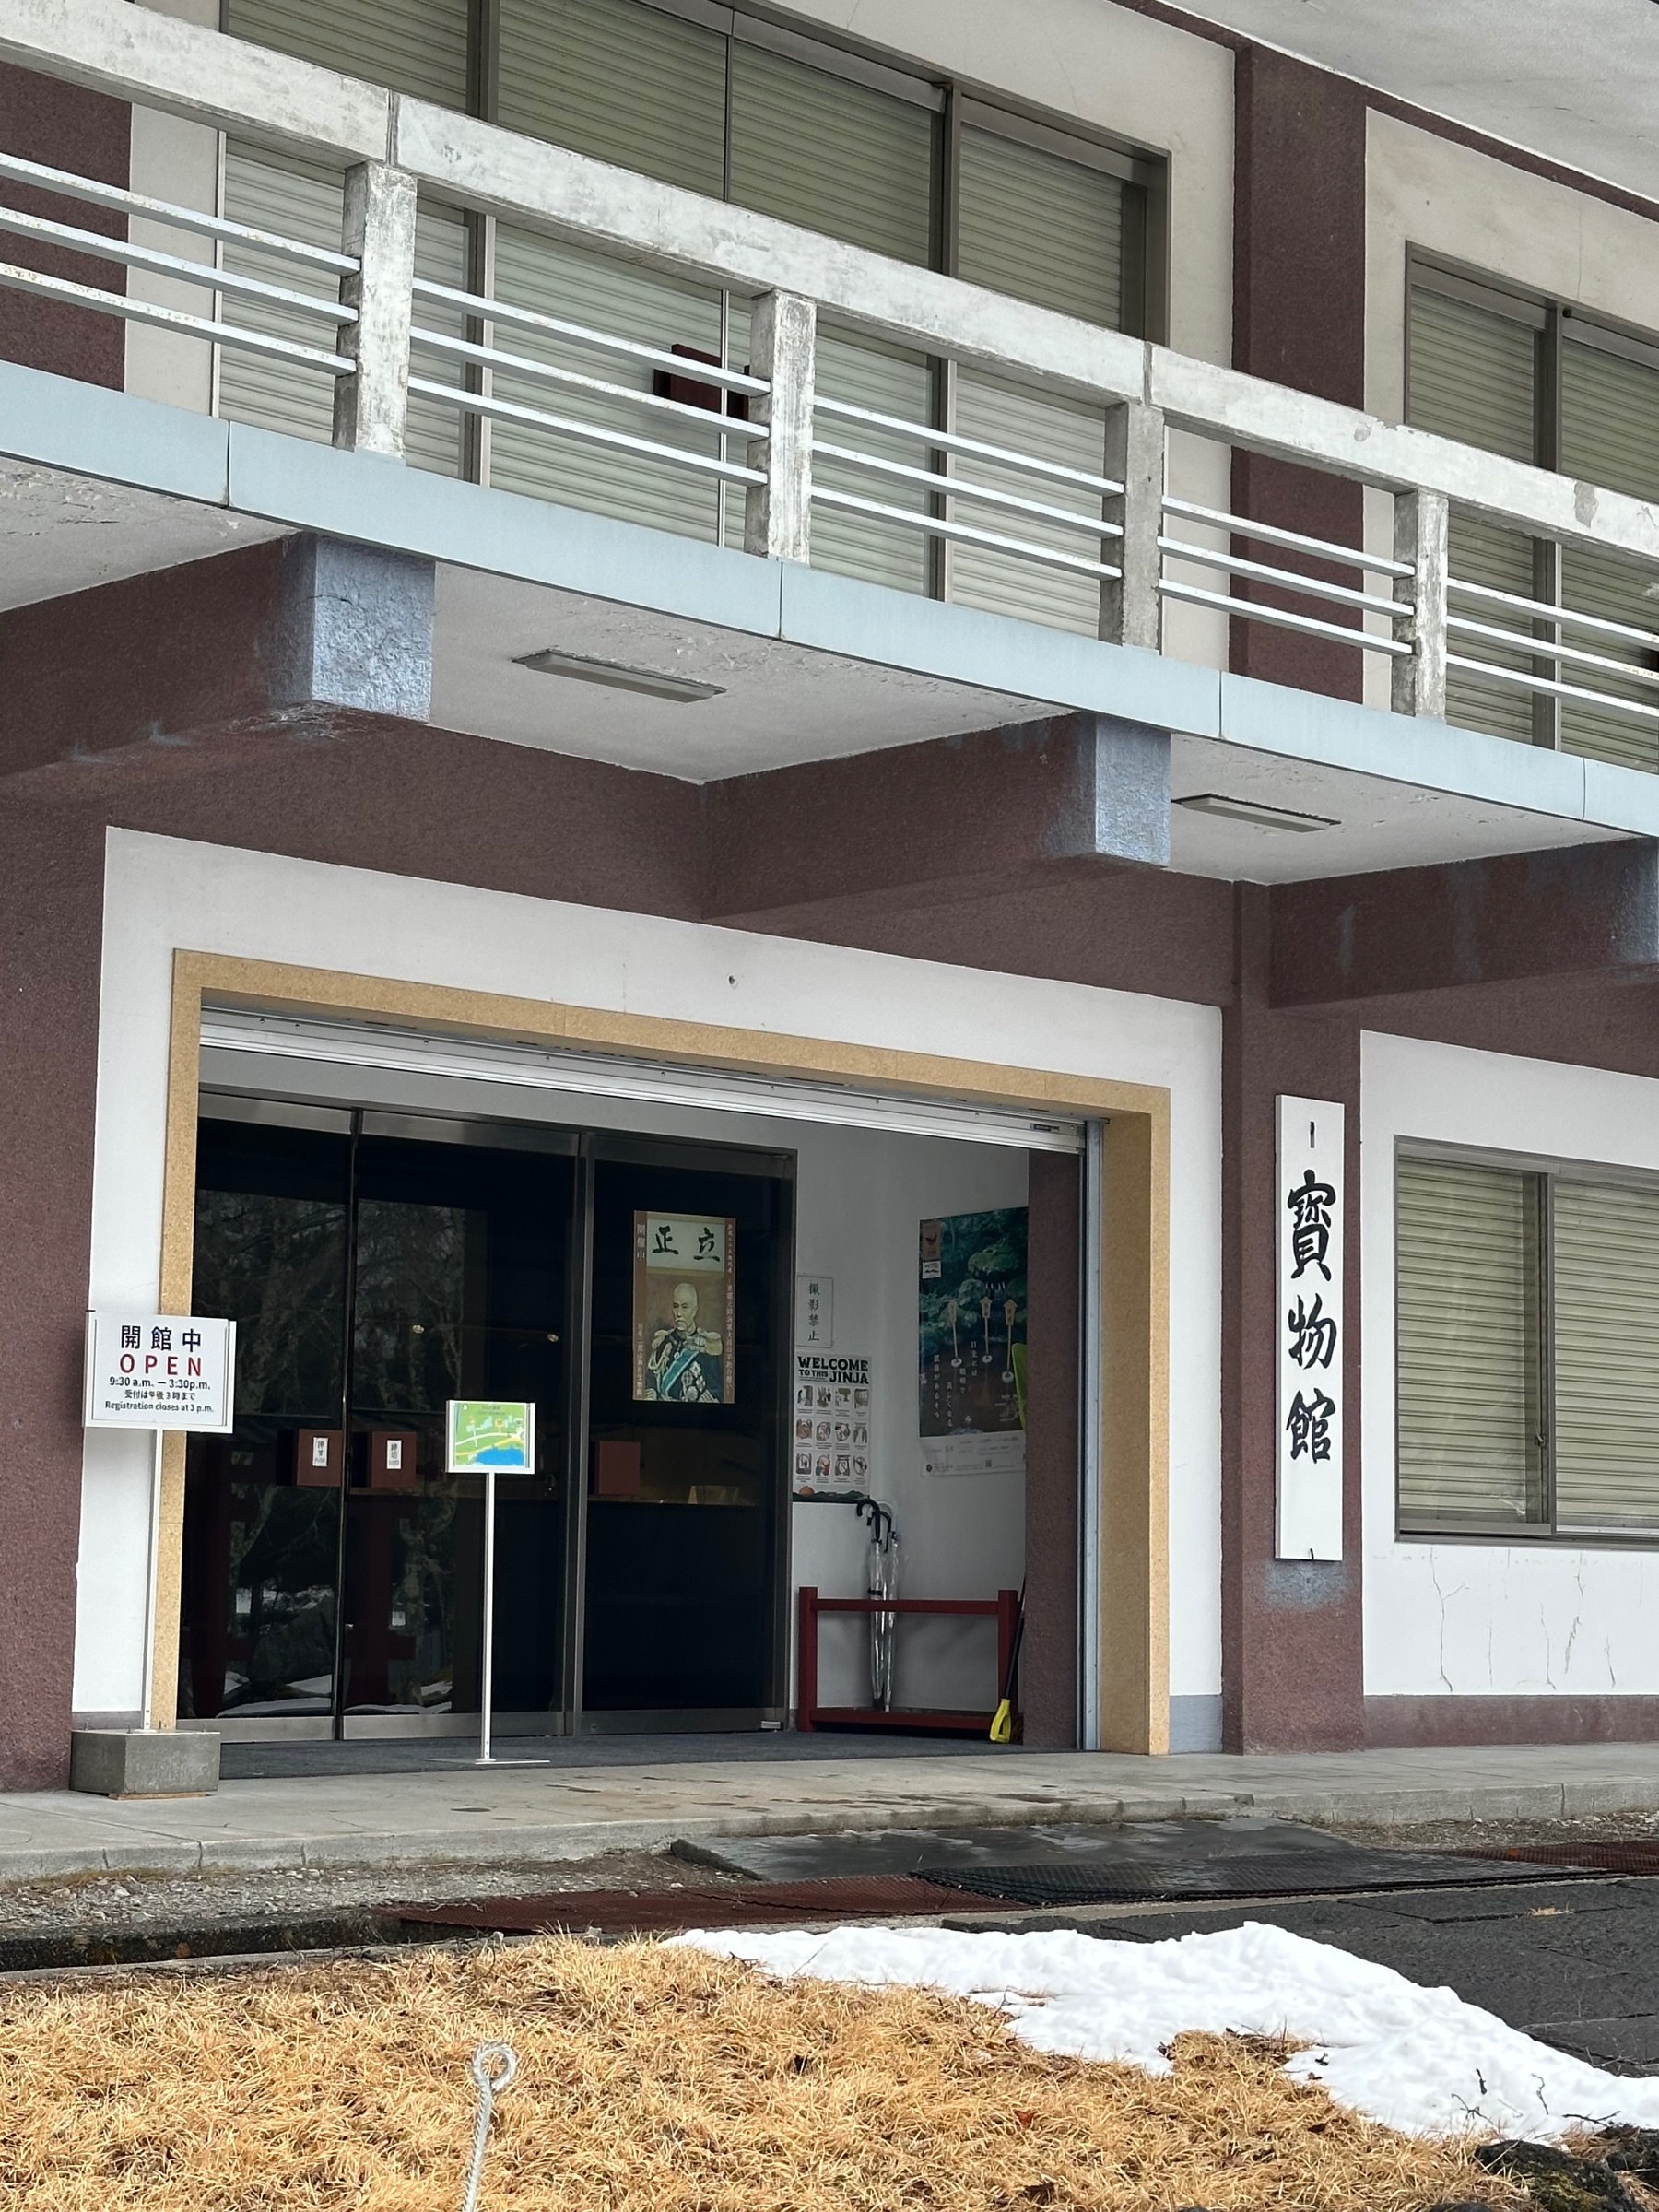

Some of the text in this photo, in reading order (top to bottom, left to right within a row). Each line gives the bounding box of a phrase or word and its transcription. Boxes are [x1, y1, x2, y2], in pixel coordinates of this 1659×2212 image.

[807, 1282, 820, 1341] 撮影禁止
[121, 1325, 202, 1352] 開館中
[120, 1353, 202, 1376] OPEN
[797, 1356, 869, 1371] WELCOME
[109, 1376, 131, 1387] 9:30
[811, 1370, 829, 1378] THIS
[830, 1371, 869, 1384] JINJA
[105, 1400, 154, 1411] Registration
[155, 1402, 180, 1411] closes
[181, 1403, 189, 1411] at
[190, 1403, 195, 1411] 3
